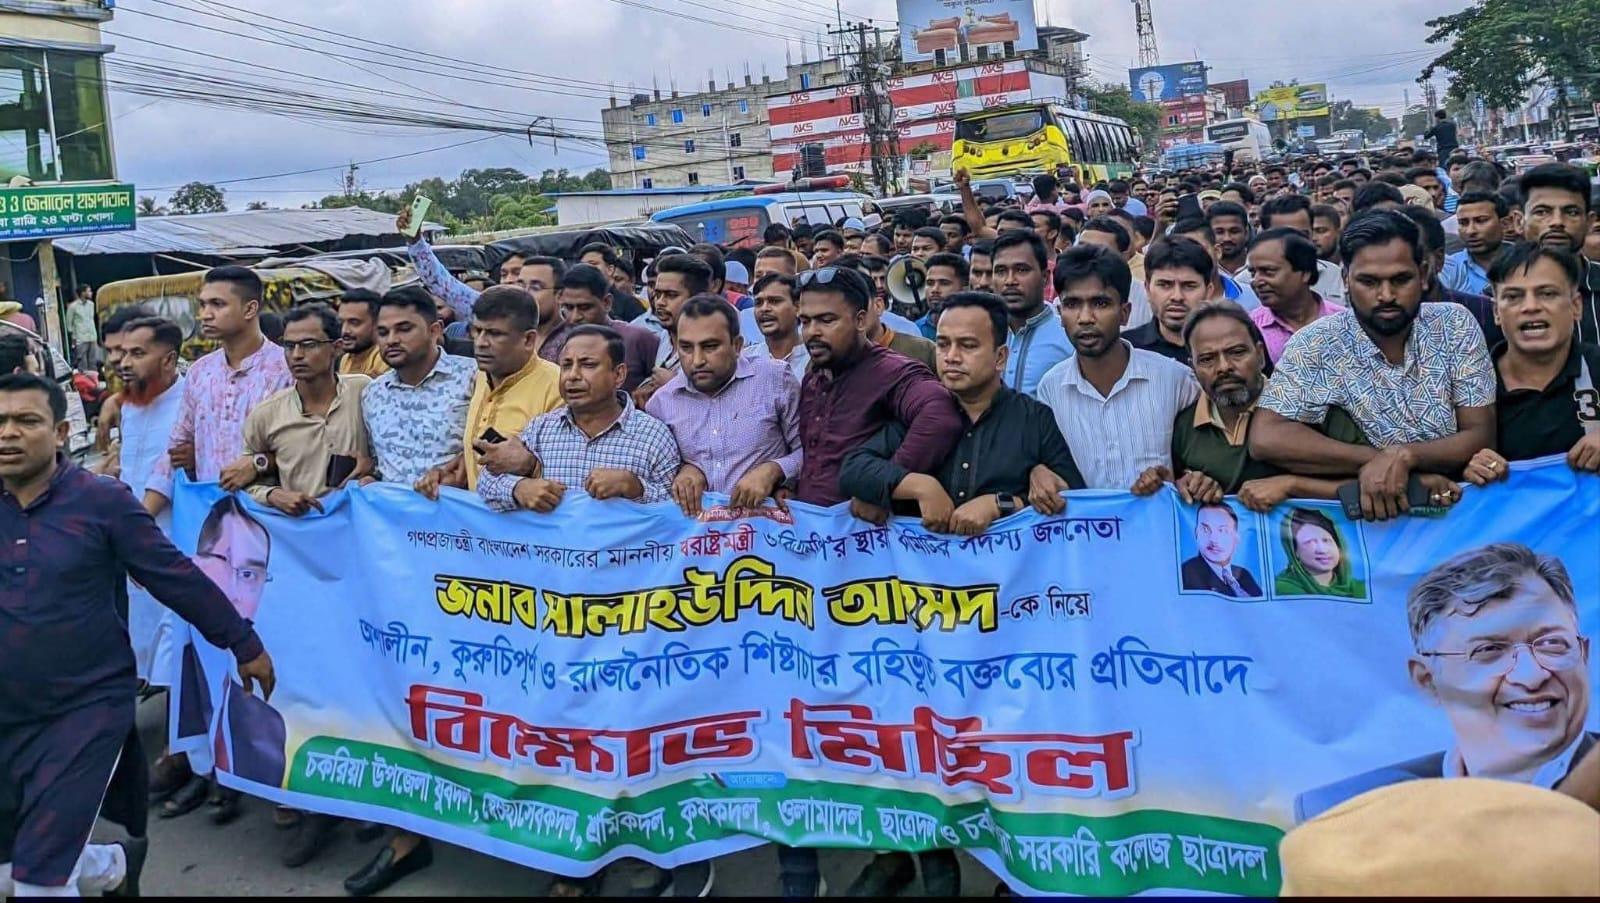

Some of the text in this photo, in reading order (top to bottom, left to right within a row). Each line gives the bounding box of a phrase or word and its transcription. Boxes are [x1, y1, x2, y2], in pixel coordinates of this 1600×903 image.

[23, 193, 74, 212] জেনারেল
[77, 191, 130, 209] হাসপাতাল
[41, 215, 58, 225] ২৪
[475, 537, 531, 561] বাংলাদেশ
[533, 543, 600, 568] সরকারের
[607, 539, 676, 567] মাননীয়
[1030, 515, 1123, 544] জননেতা
[434, 573, 537, 629] জনাব
[541, 554, 815, 638] সালাহউদ্দিন
[1045, 585, 1091, 617] নিয়ে
[449, 634, 540, 696] কুরুচিপূর্ণ
[541, 659, 557, 691] ও
[567, 641, 732, 693] রাজনৈতিক
[739, 630, 841, 688] শিষ্টাচার
[938, 652, 1078, 699] বক্তব্যের
[1090, 635, 1254, 697] প্রতিবাদে
[403, 683, 1135, 795] বিক্ষোভ মিছিল
[305, 746, 368, 788] চকরিয়া
[371, 752, 433, 803] উপজেলা
[677, 796, 770, 840] কৃষকদল,
[776, 796, 874, 847] ওলামাদল,
[940, 825, 961, 846] ও
[1014, 825, 1104, 879] সরকারি
[1104, 832, 1173, 876] কলেজ
[1177, 834, 1269, 881] ছাত্রদল
